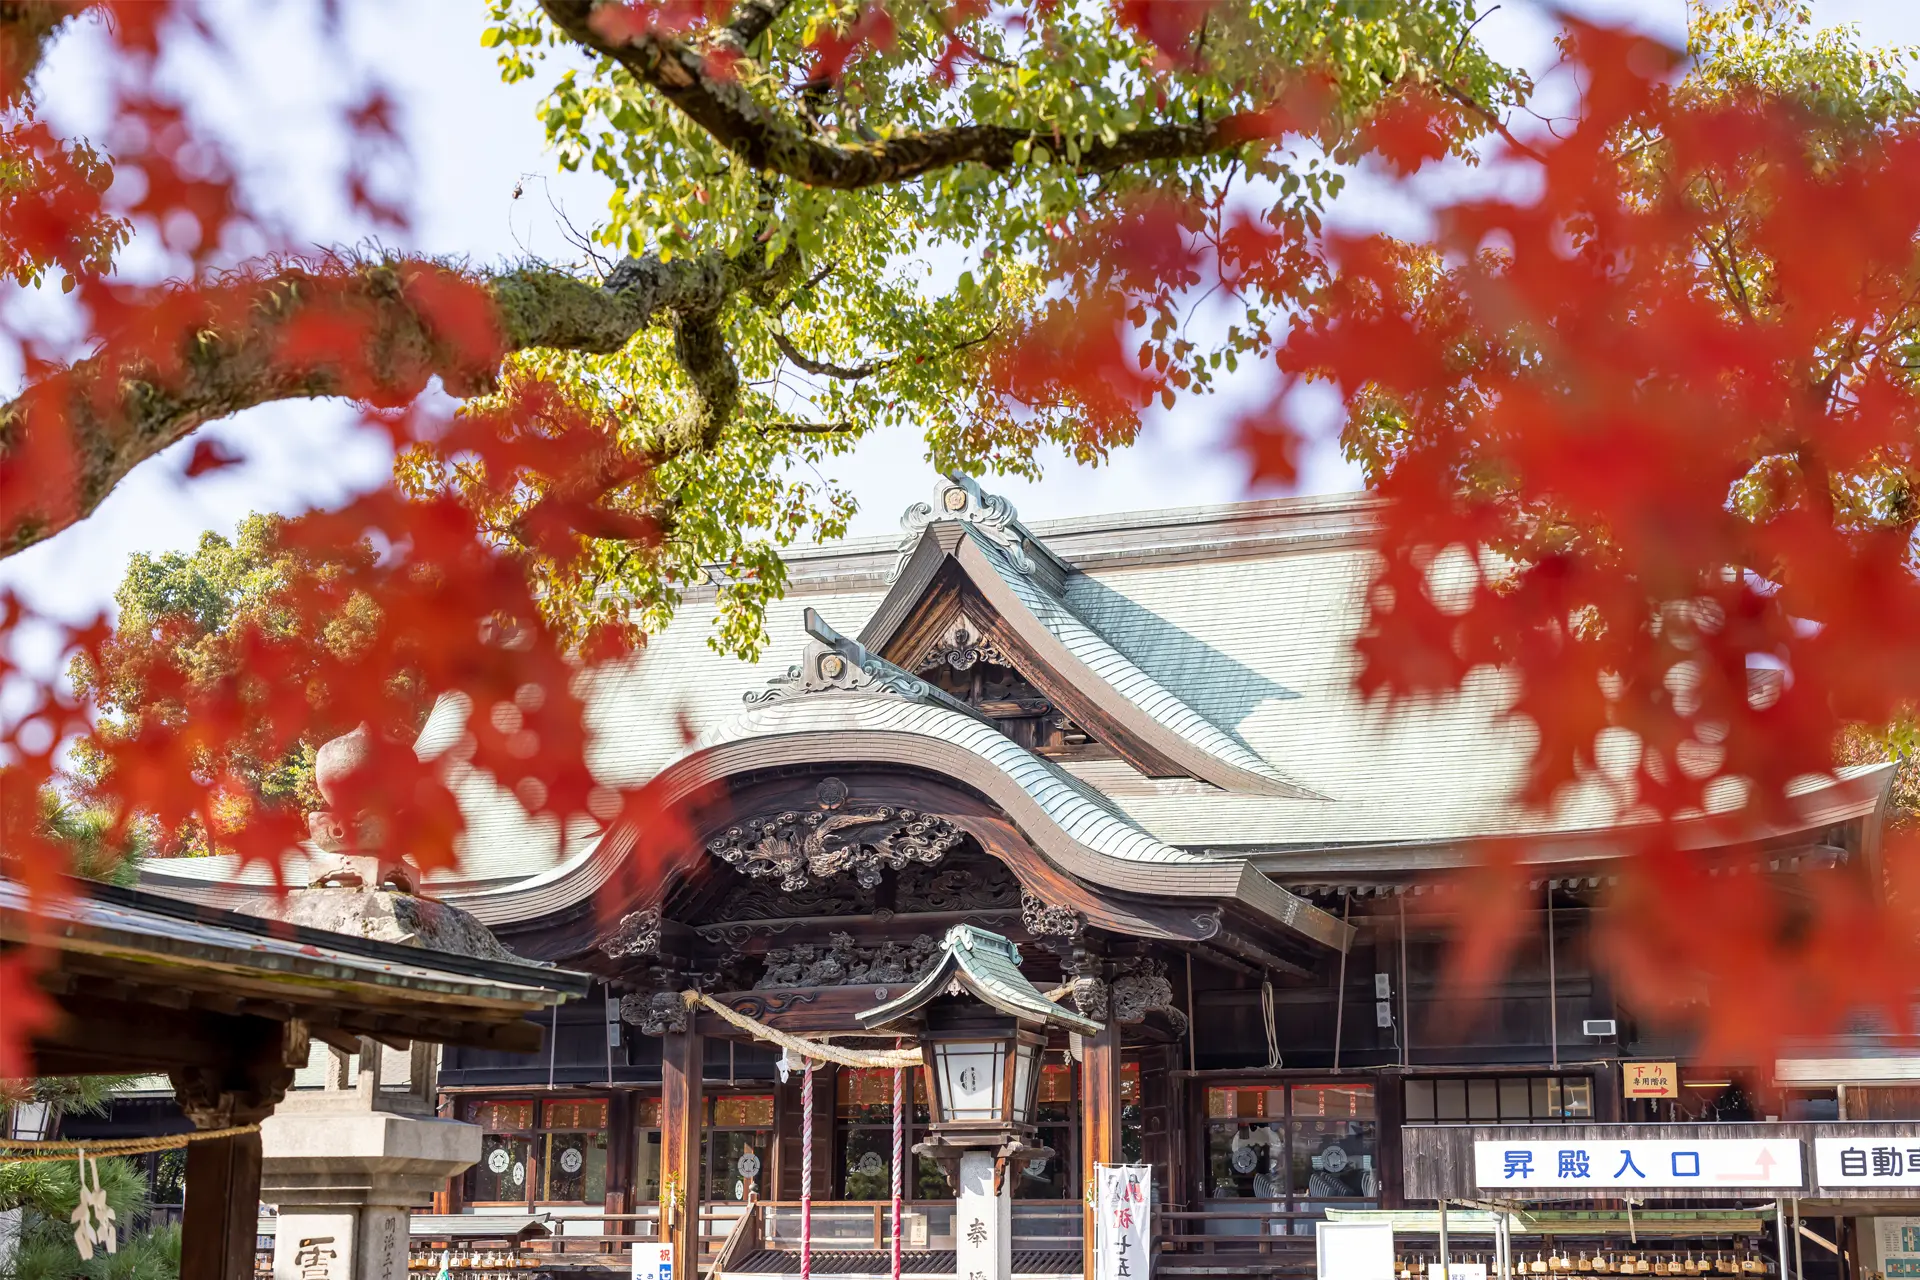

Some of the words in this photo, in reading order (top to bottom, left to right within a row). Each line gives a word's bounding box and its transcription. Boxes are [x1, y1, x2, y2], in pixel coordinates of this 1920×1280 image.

[1633, 1066, 1663, 1078] 下り
[1633, 1077, 1668, 1086] 専用階段
[1503, 1149, 1701, 1179] 昇殿入口
